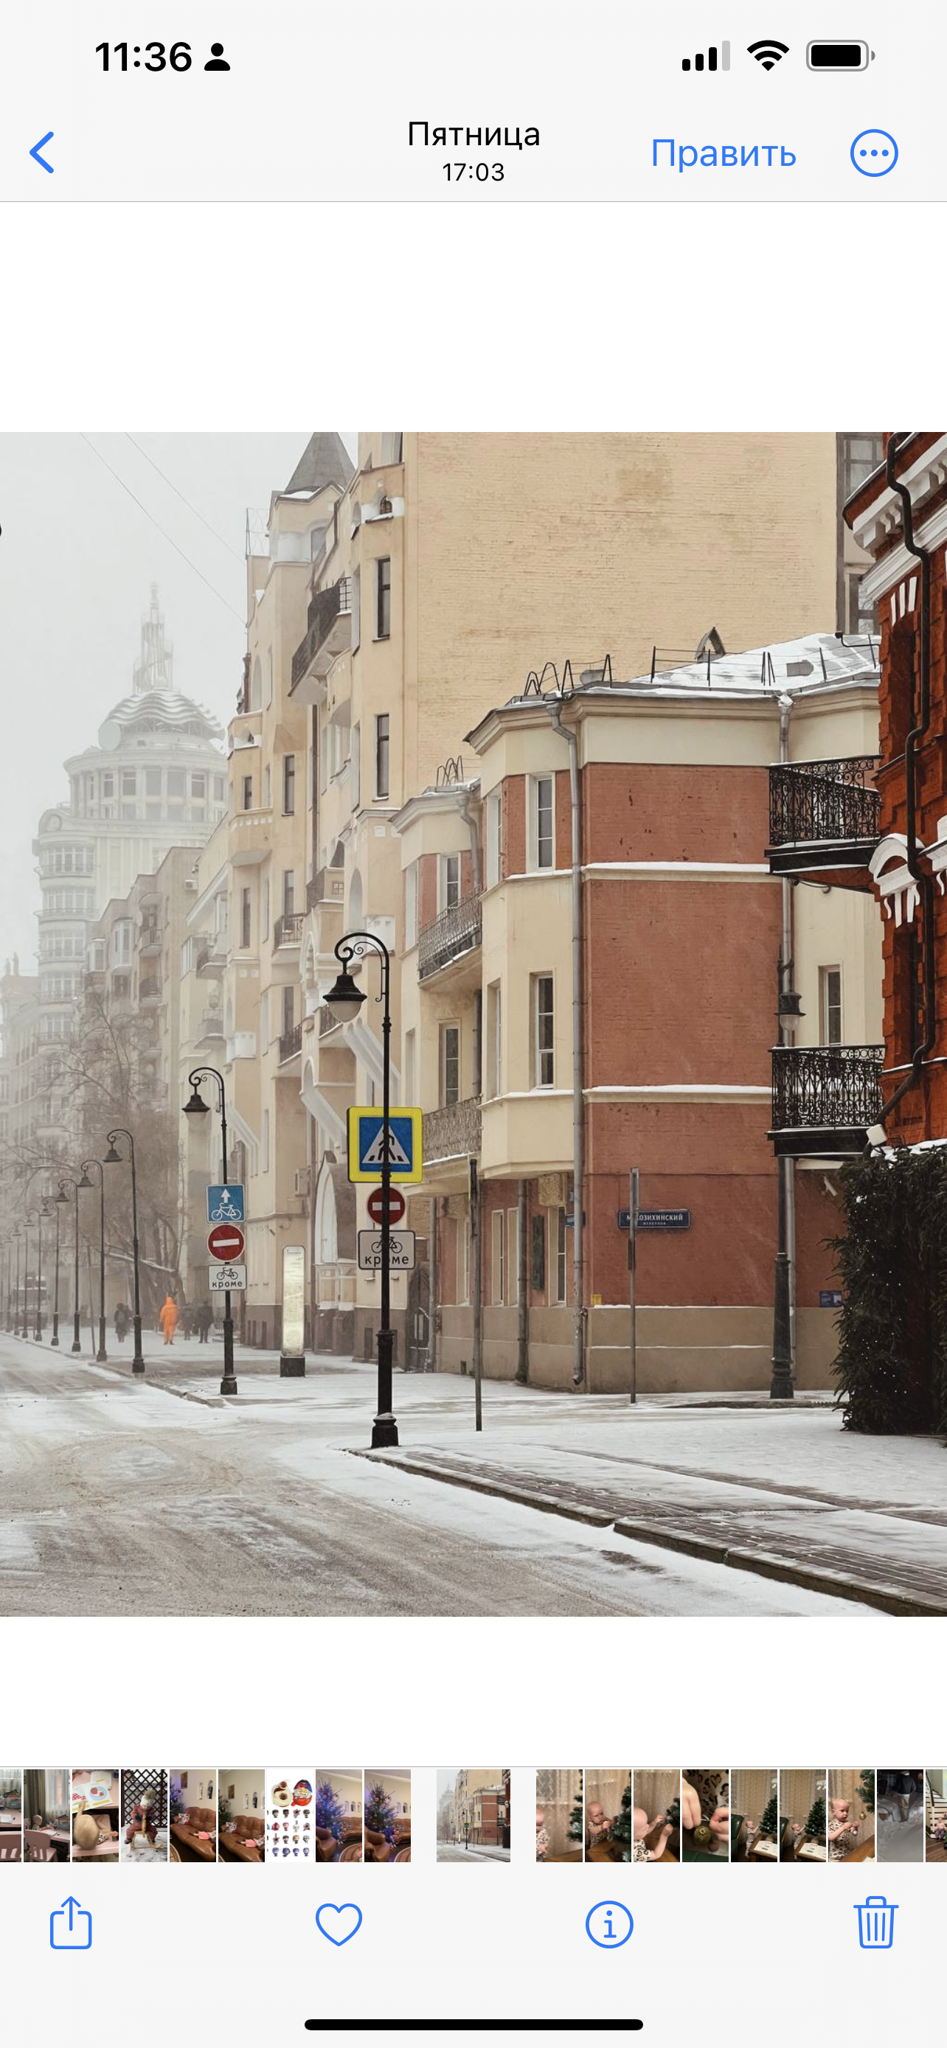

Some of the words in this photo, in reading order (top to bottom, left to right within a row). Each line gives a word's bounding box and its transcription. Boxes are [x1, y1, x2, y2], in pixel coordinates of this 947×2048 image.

[95, 41, 193, 73] 11:36
[408, 120, 540, 151] Пятница
[652, 138, 797, 174] Править
[442, 162, 505, 183] 17:03
[364, 1255, 409, 1268] крме
[211, 1281, 243, 1289] кроме
